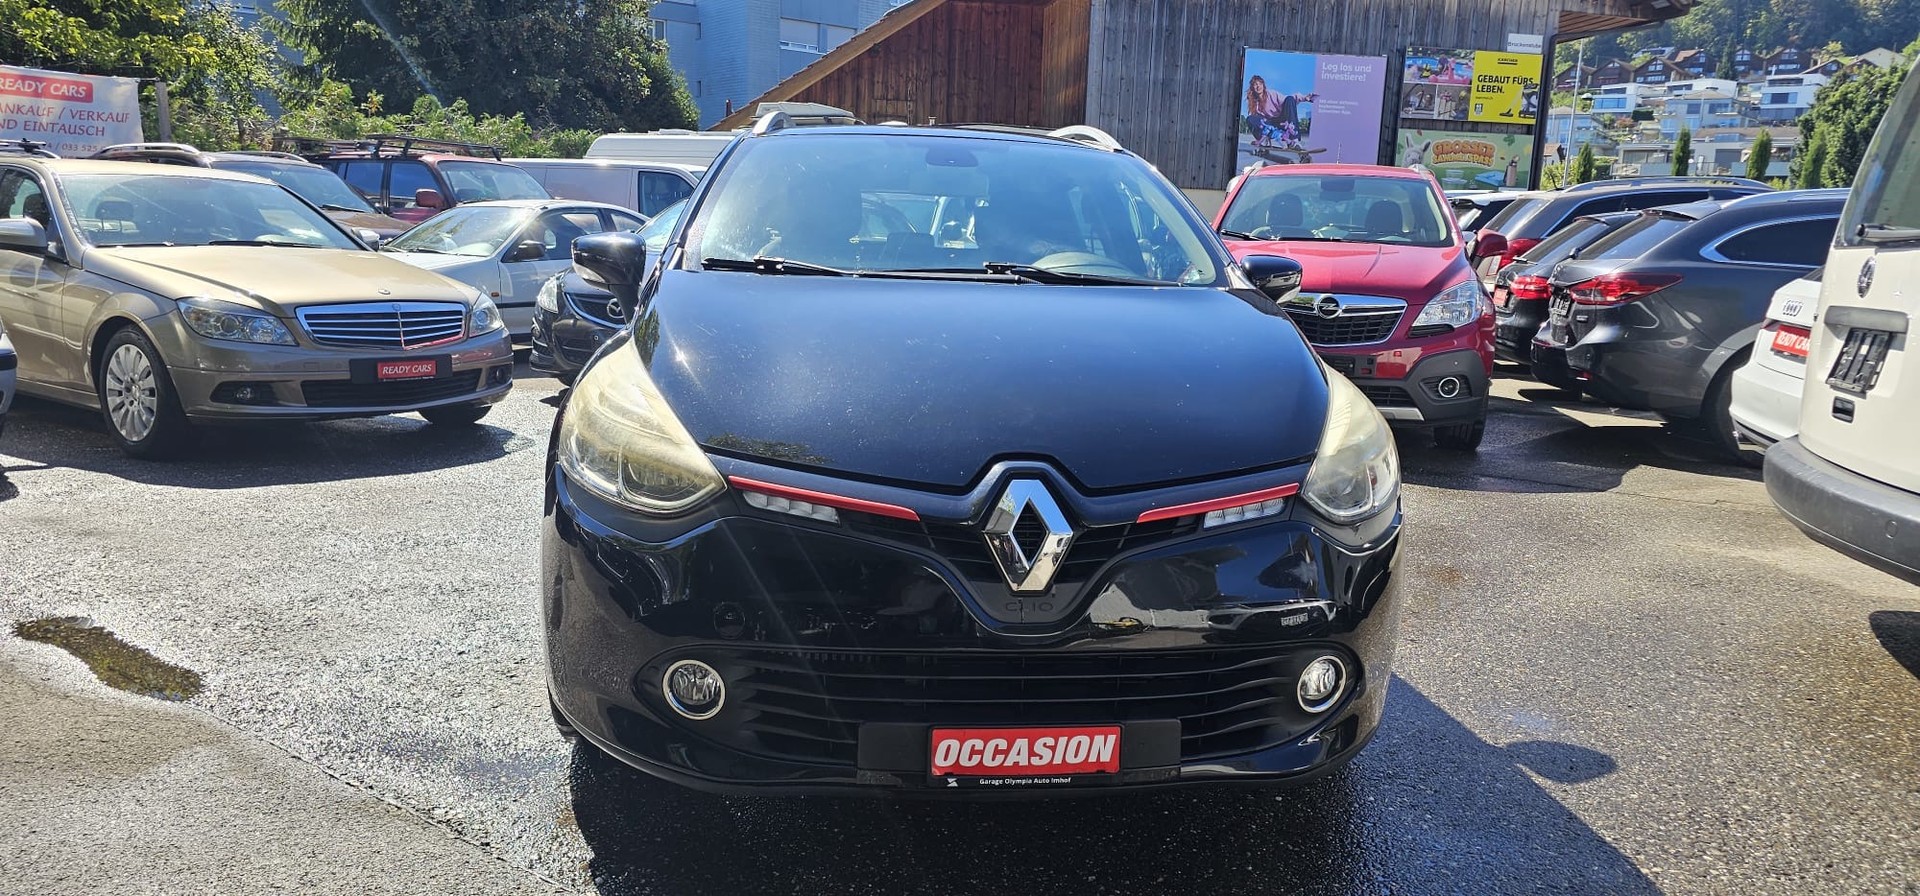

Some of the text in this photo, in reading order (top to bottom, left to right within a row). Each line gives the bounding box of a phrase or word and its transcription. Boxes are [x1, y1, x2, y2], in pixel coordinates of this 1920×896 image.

[1322, 62, 1372, 72] Leg los und
[1321, 71, 1367, 82] investiere!
[1477, 74, 1534, 86] GEBAUT FÜRS
[50, 83, 87, 98] CARS
[1476, 85, 1504, 94] LEBEN.
[59, 107, 66, 120] /
[70, 109, 130, 123] VERKAUF
[0, 118, 105, 137] ND EINTAUSCH
[1432, 140, 1495, 157] GROSSER
[382, 364, 432, 375] READY CARS
[1006, 602, 1054, 613] CLIO
[934, 734, 1117, 767] OCCASION
[979, 778, 1003, 786] Garage
[1004, 777, 1032, 785] Olympia
